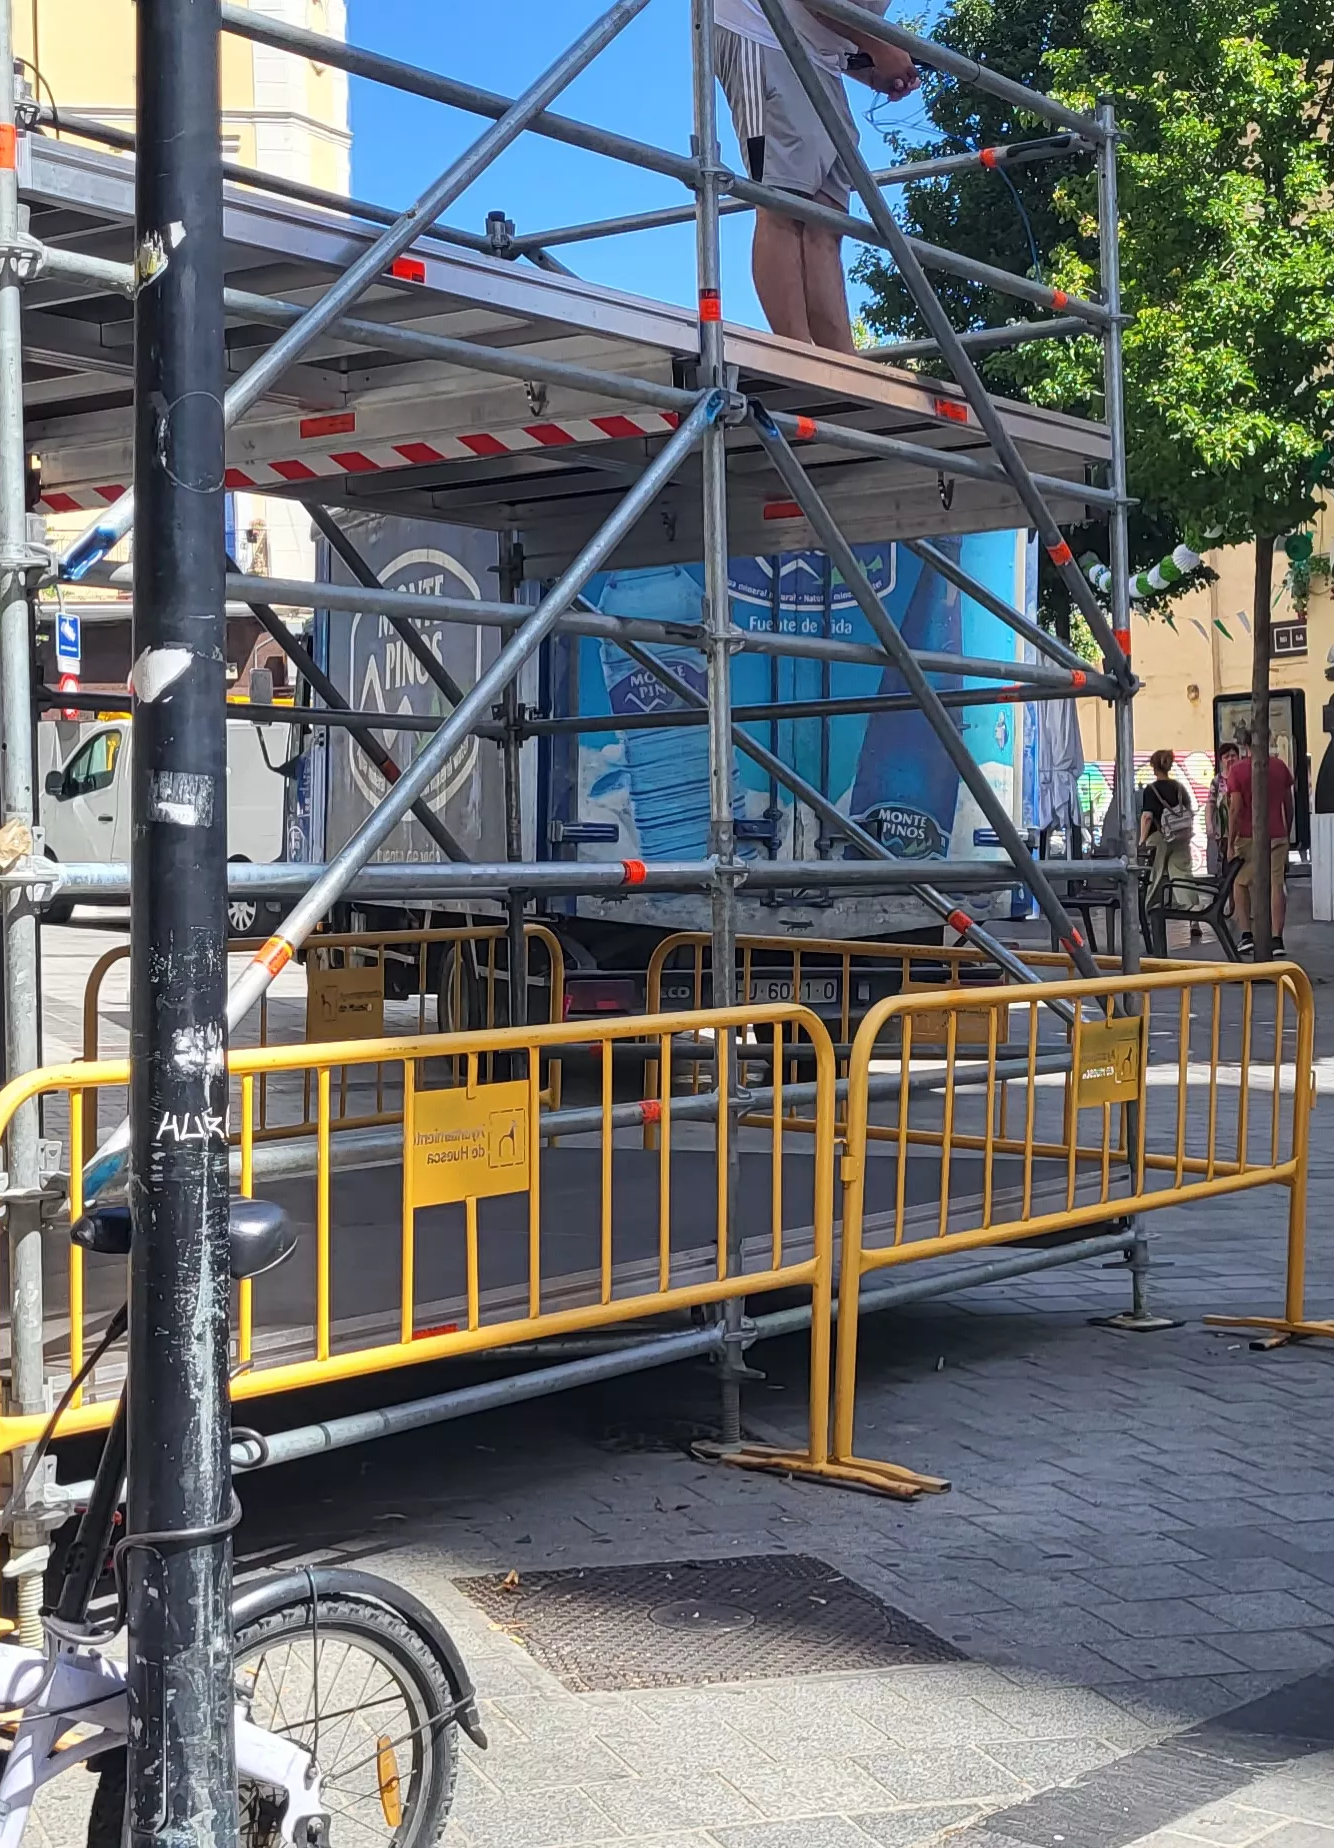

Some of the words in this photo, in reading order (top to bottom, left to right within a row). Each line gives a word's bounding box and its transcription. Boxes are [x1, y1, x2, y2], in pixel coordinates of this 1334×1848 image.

[802, 616, 818, 633] de
[823, 617, 853, 634] ida
[630, 664, 686, 688] MOE
[638, 683, 668, 699] PIN
[878, 808, 928, 828] MONTE
[882, 821, 925, 839] PINOS
